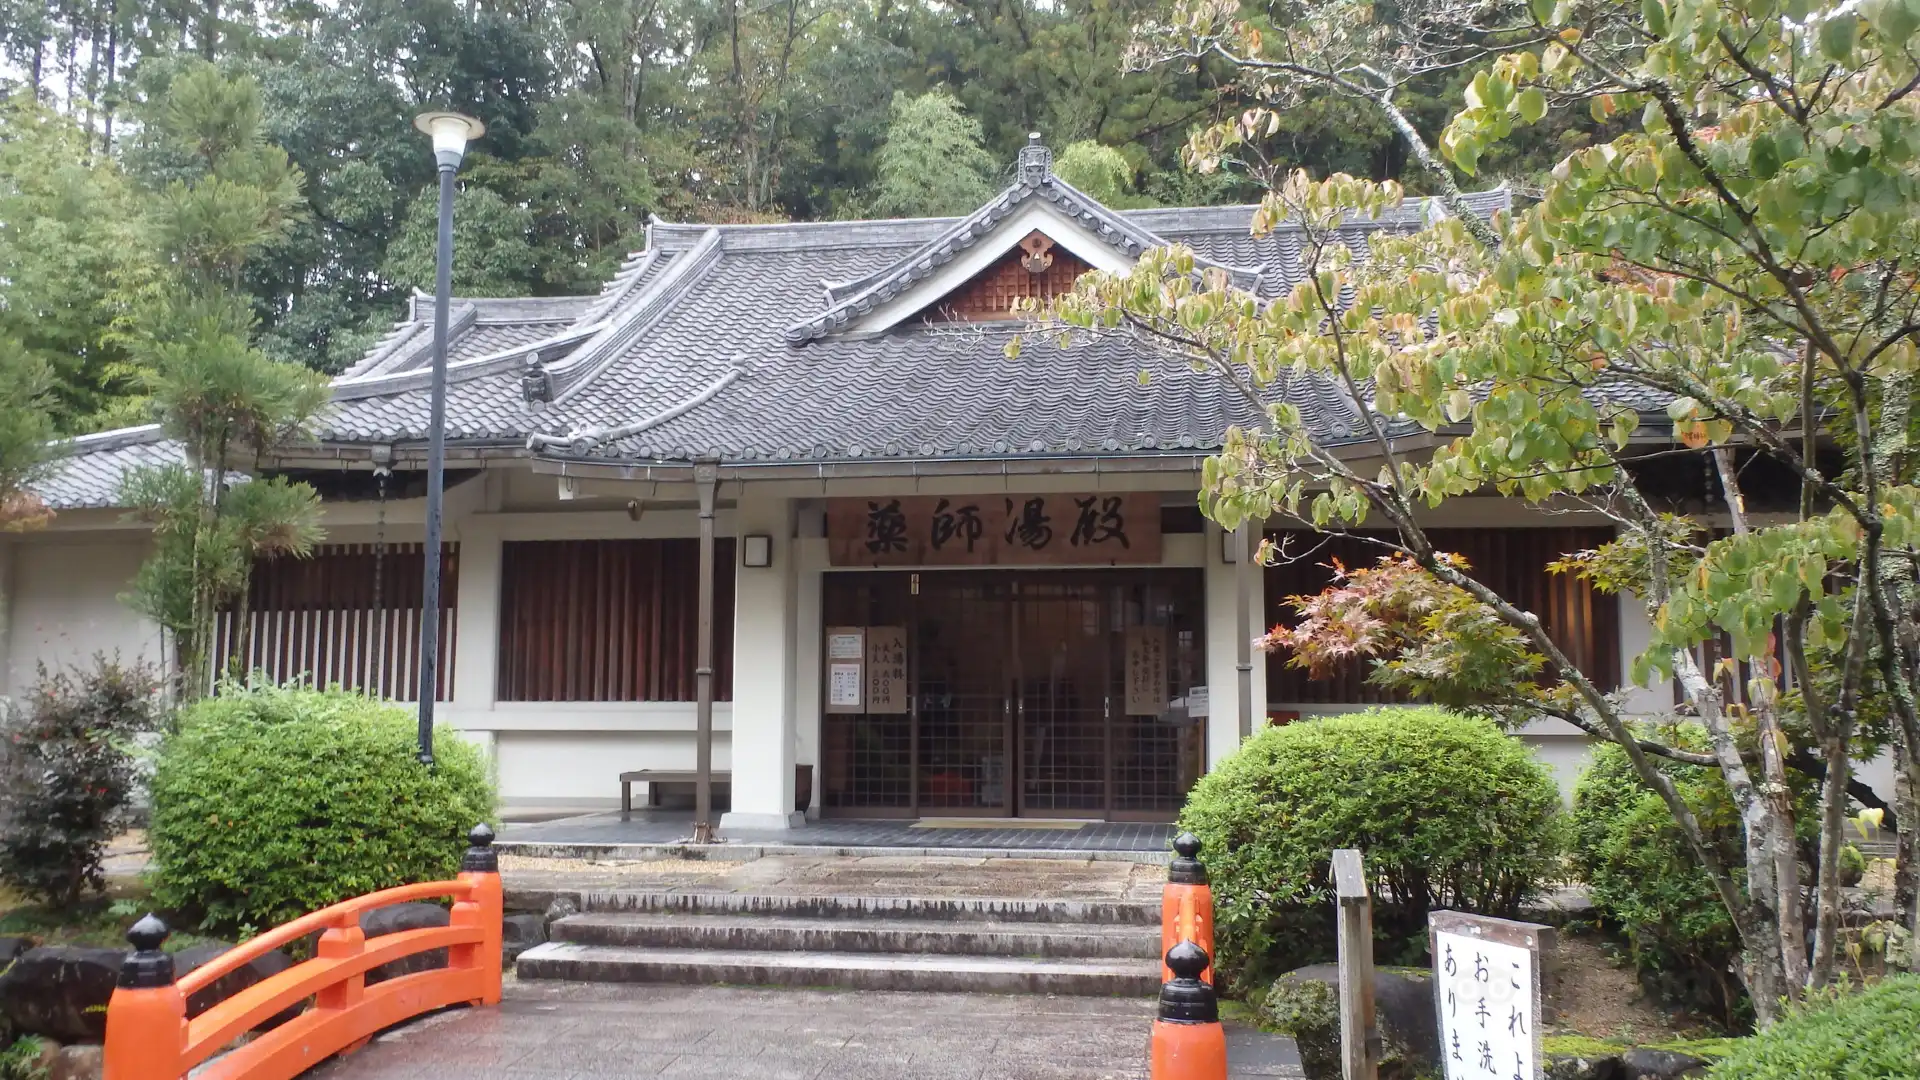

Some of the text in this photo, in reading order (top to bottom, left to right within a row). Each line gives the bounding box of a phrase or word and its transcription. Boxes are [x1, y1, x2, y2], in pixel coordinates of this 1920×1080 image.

[1444, 943, 1465, 1080] ありま
[1474, 952, 1497, 1075] お手洗
